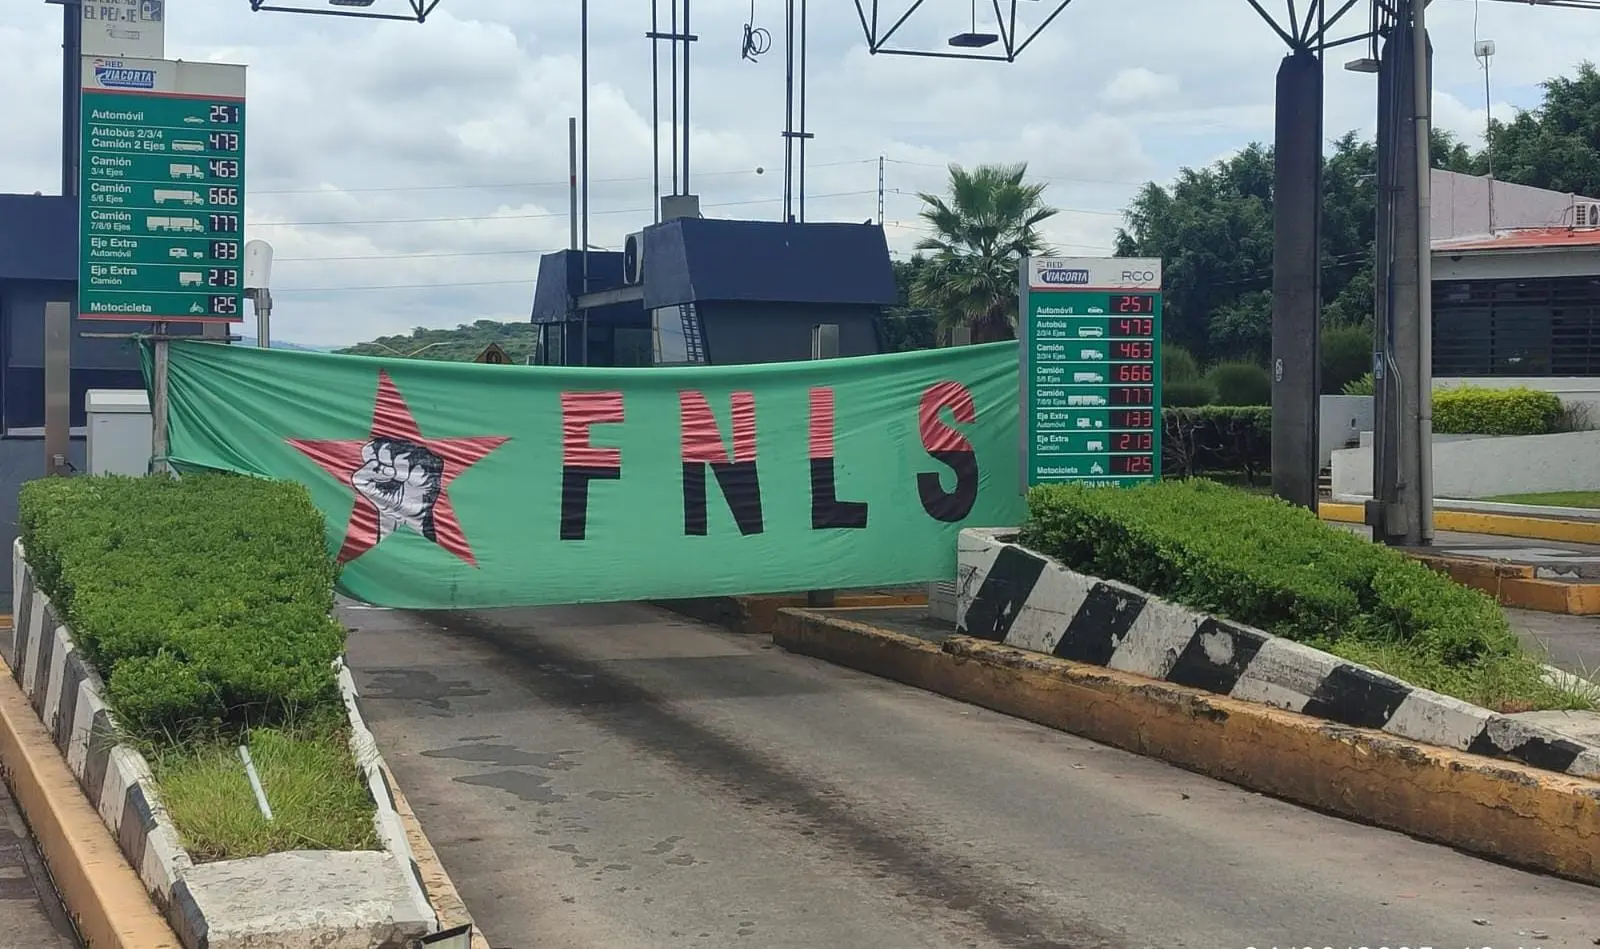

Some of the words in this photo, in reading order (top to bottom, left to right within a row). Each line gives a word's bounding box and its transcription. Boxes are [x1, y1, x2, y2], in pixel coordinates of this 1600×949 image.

[84, 5, 97, 19] EL
[104, 60, 123, 68] RED
[105, 69, 152, 82] VIACORTA
[91, 109, 144, 121] Automóvil
[209, 105, 239, 123] 251
[91, 127, 135, 138] Autobús
[137, 129, 163, 139] 2/3/4
[91, 138, 133, 149] Camión
[134, 141, 141, 150] 2
[143, 141, 165, 151] Ejes
[209, 133, 239, 151] 473
[91, 156, 132, 166] Camión
[91, 168, 104, 176] 3/4
[106, 168, 124, 177] Ejes
[209, 160, 239, 178] 463
[91, 182, 132, 194] Camión
[91, 194, 103, 203] 5/6
[105, 194, 123, 204] Ejes
[209, 187, 238, 206] 666
[91, 210, 132, 221] Camión
[113, 222, 131, 232] Ejes
[209, 214, 238, 232] 777
[91, 237, 108, 248] Eje
[110, 238, 138, 248] Extra
[90, 249, 132, 258] Automóvil
[214, 242, 238, 260] 133
[91, 265, 108, 276] Eje
[110, 266, 138, 276] Extra
[1046, 270, 1088, 281] VIACORTA
[1121, 271, 1154, 281] RCO
[90, 277, 122, 286] Camión
[208, 269, 238, 287] 213
[90, 302, 152, 313] Motocicleta
[213, 296, 237, 313] 125
[1036, 306, 1073, 314] Automóvil
[1120, 296, 1153, 312] 251
[1036, 320, 1067, 328] Autobús
[1120, 319, 1152, 335] 473
[1053, 329, 1066, 337] Ejes
[1036, 343, 1065, 351] Camión
[1120, 342, 1152, 358] 463
[1036, 366, 1065, 374] Camión
[1120, 365, 1152, 381] 666
[1047, 375, 1061, 383] Ejes
[1036, 389, 1065, 397] Camión
[1121, 388, 1152, 404] 777
[1036, 412, 1048, 420] Eje
[1050, 412, 1069, 420] Extra
[1126, 411, 1152, 427] 133
[1036, 435, 1048, 443] Eje
[1120, 434, 1152, 450] 213
[560, 379, 979, 541] FNLS
[1126, 456, 1152, 472] 125
[1036, 466, 1078, 474] Motocicleta
